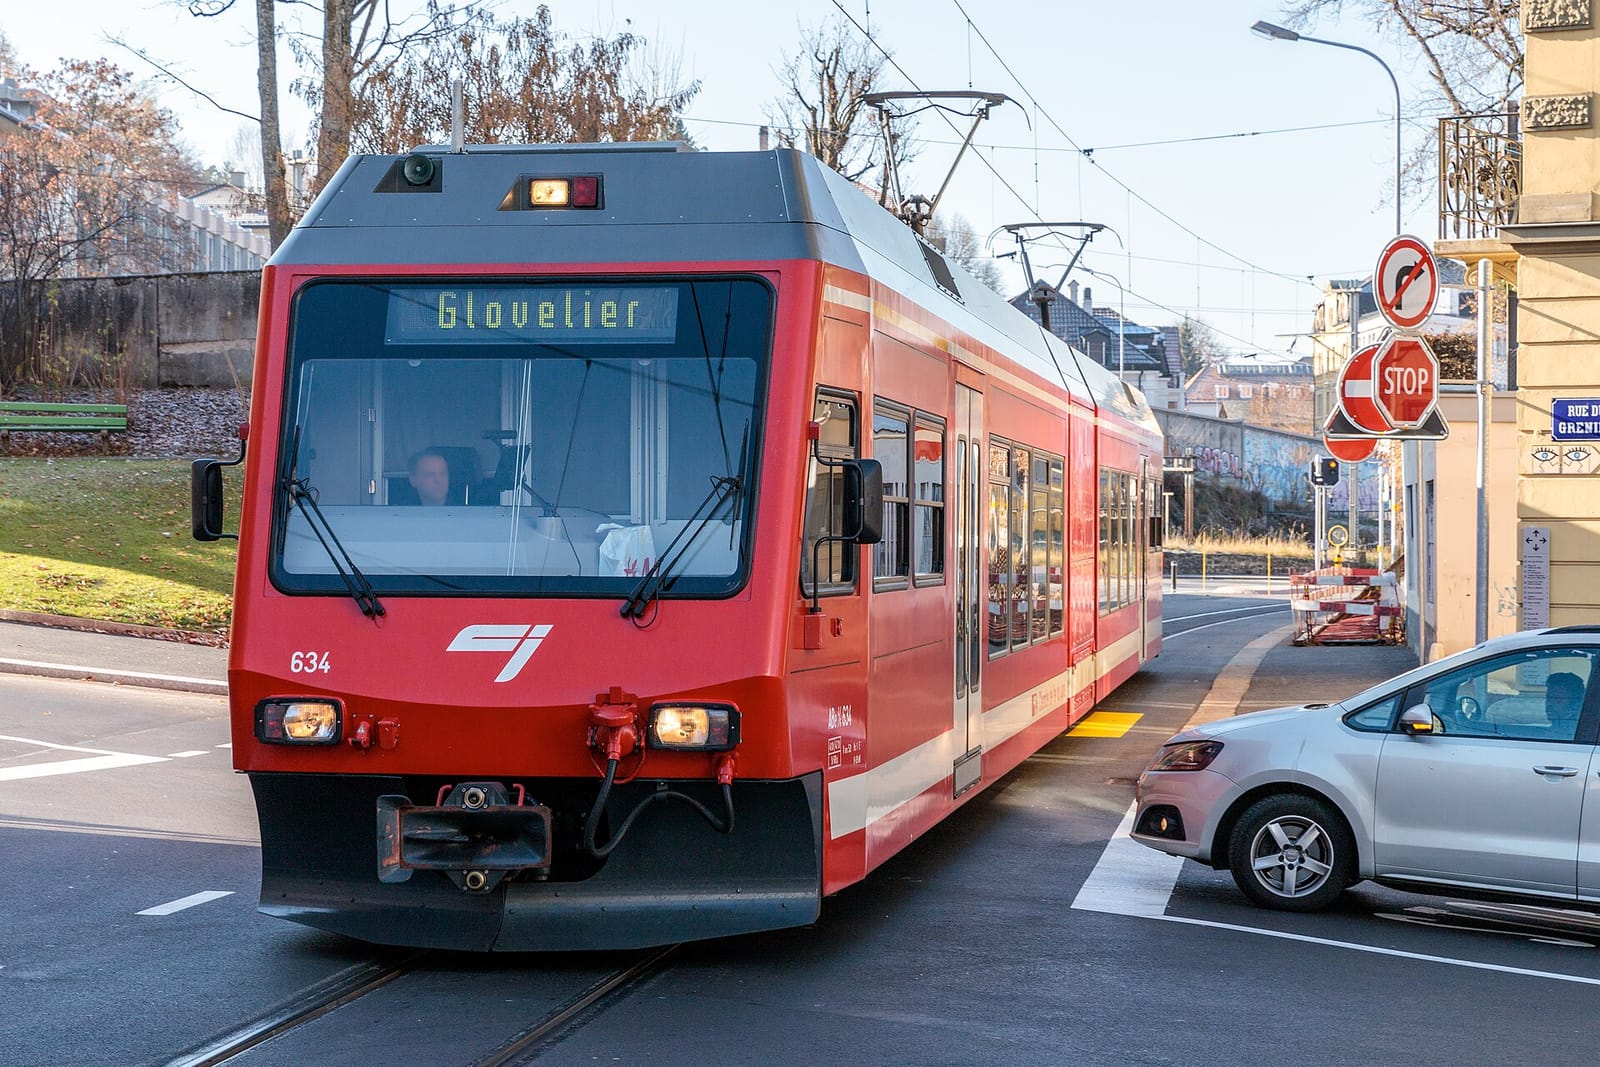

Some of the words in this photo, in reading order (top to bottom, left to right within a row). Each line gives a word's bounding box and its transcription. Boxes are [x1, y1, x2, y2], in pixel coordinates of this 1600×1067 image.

[438, 290, 639, 329] Glovelier
[1384, 366, 1429, 396] STOP
[1567, 404, 1589, 417] RUE
[1591, 404, 1600, 417] D
[1558, 421, 1600, 434] GRENI
[290, 651, 331, 674] 634
